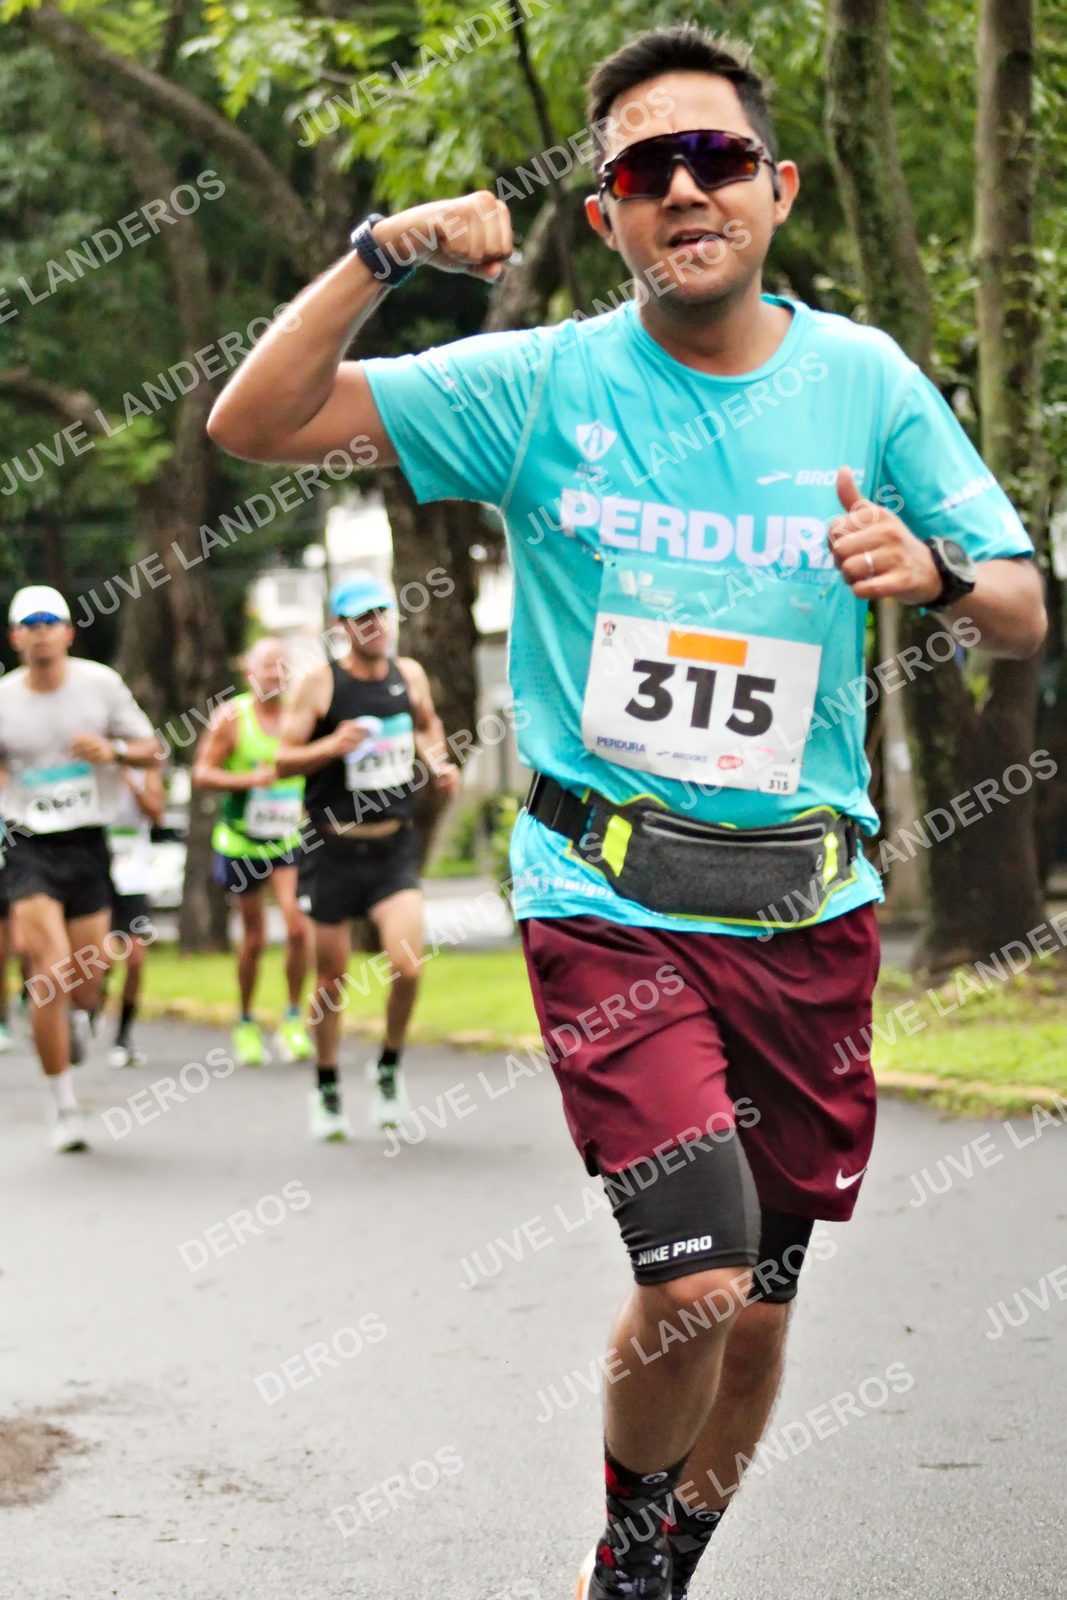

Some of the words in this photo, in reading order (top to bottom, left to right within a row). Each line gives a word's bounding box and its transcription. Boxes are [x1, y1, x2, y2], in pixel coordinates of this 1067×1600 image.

[625, 658, 776, 737] 315
[596, 736, 647, 752] PERDURA
[768, 779, 789, 790] 315
[638, 1245, 670, 1266] NIKE
[672, 1235, 713, 1258] PRO
